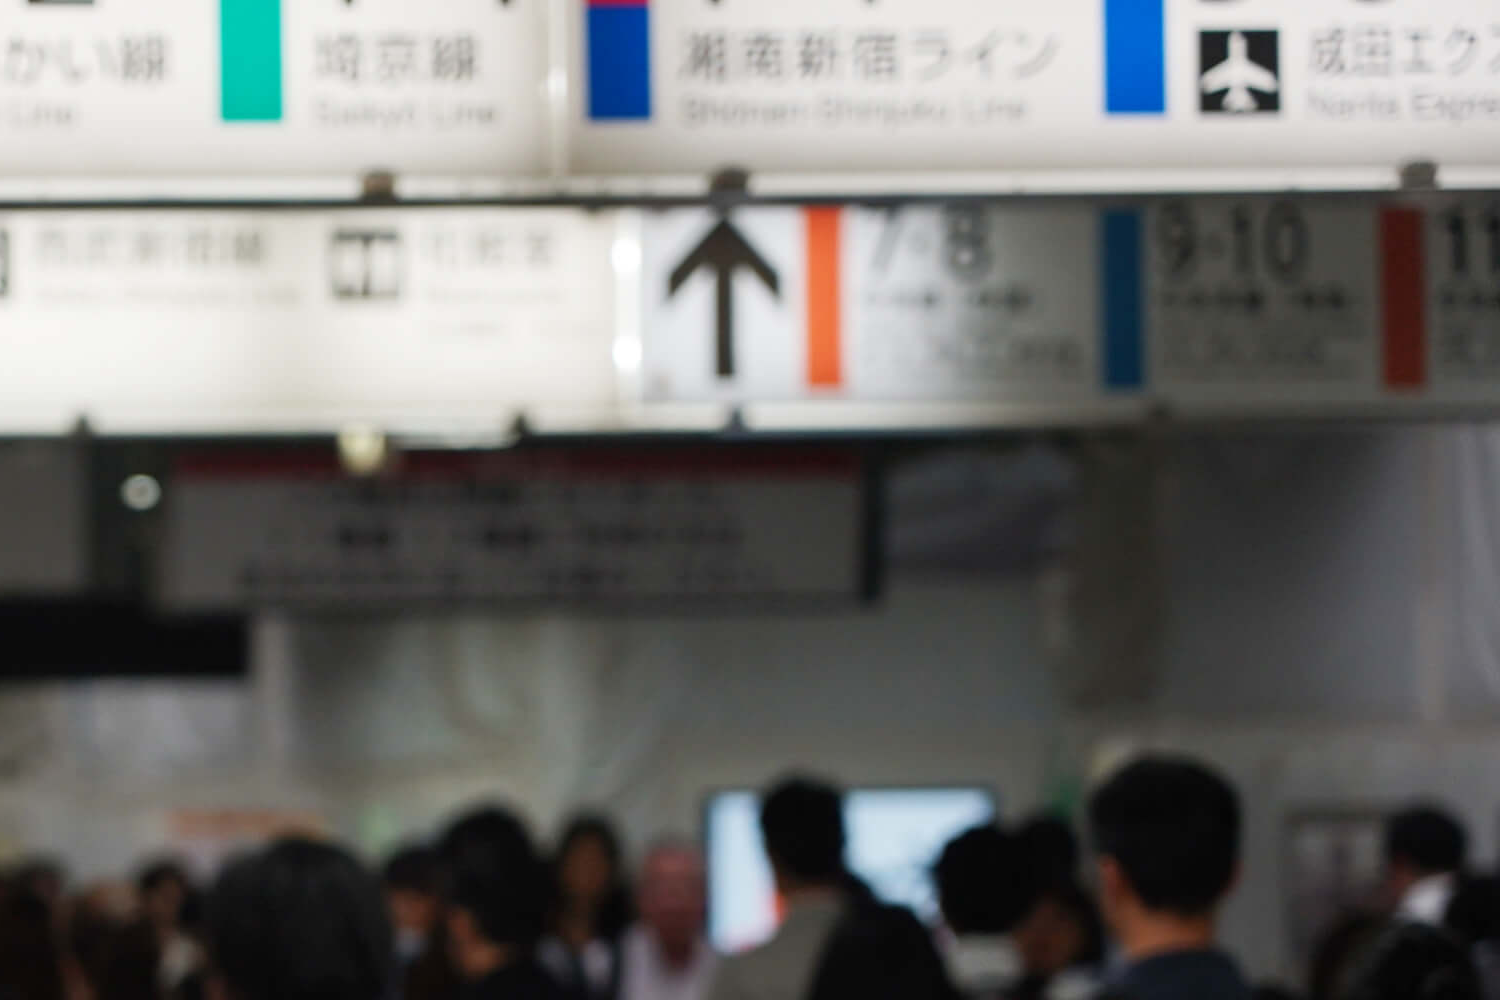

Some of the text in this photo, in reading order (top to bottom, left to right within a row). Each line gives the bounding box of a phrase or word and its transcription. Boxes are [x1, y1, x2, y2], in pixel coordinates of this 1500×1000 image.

[313, 32, 479, 82] 埼京線
[679, 29, 1060, 82] 湘南新宿ライン
